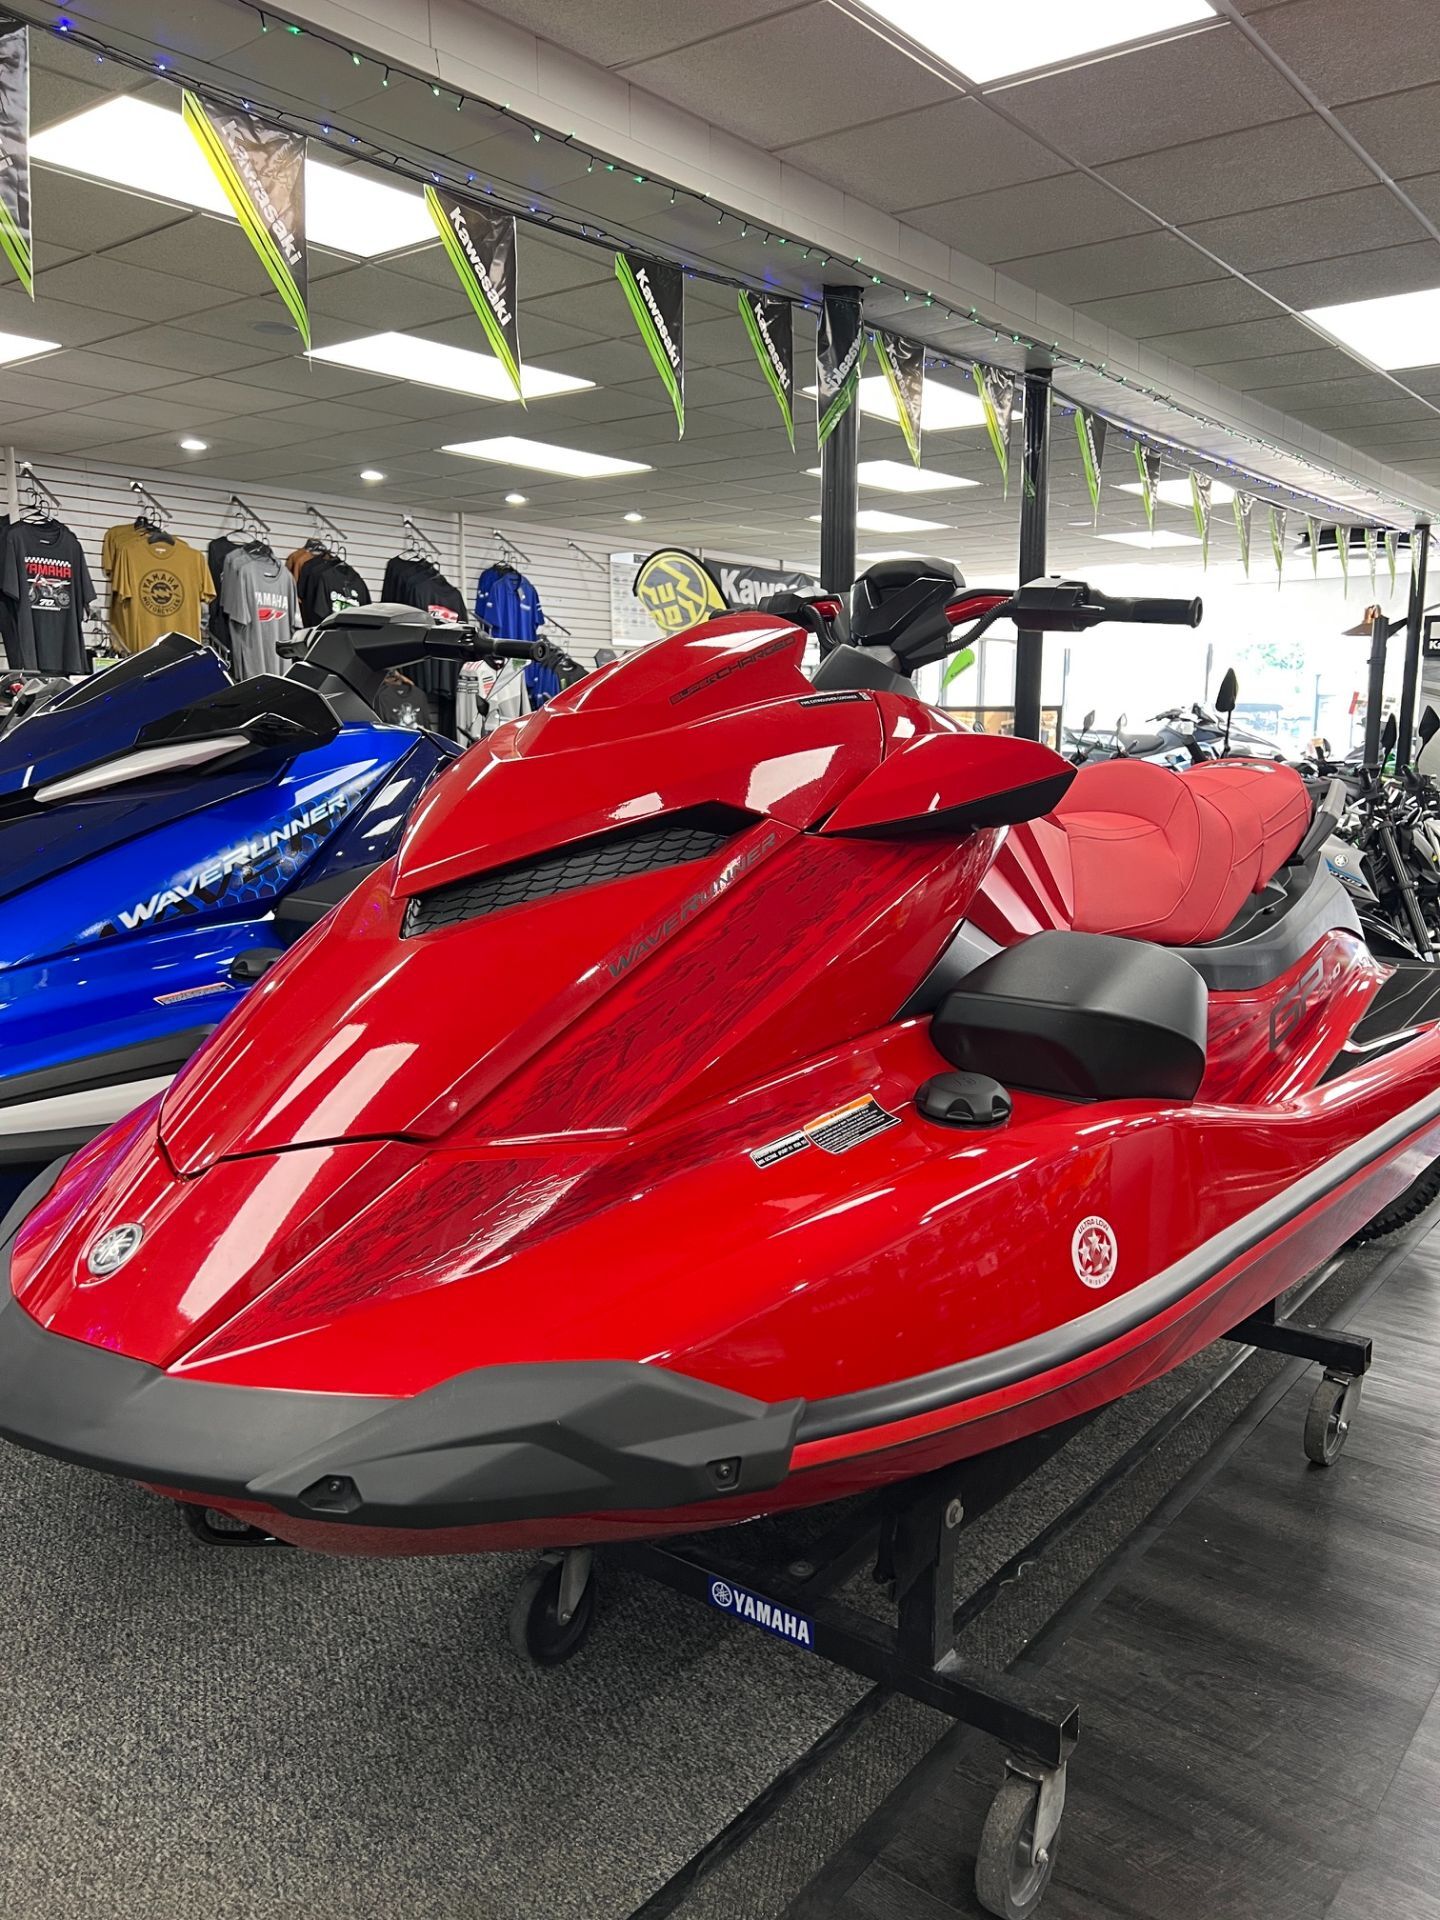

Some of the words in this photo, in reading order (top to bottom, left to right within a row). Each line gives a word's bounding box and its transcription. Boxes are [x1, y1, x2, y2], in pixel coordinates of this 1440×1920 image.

[449, 206, 512, 326] Kawasaki
[635, 268, 681, 368] Kawasaki
[754, 302, 790, 390] Kawasaki
[143, 573, 179, 589] YAMAHA
[1078, 1218, 1095, 1234] ULTRA
[1095, 1218, 1110, 1232] LOW
[733, 1589, 810, 1645] YAMAHA
